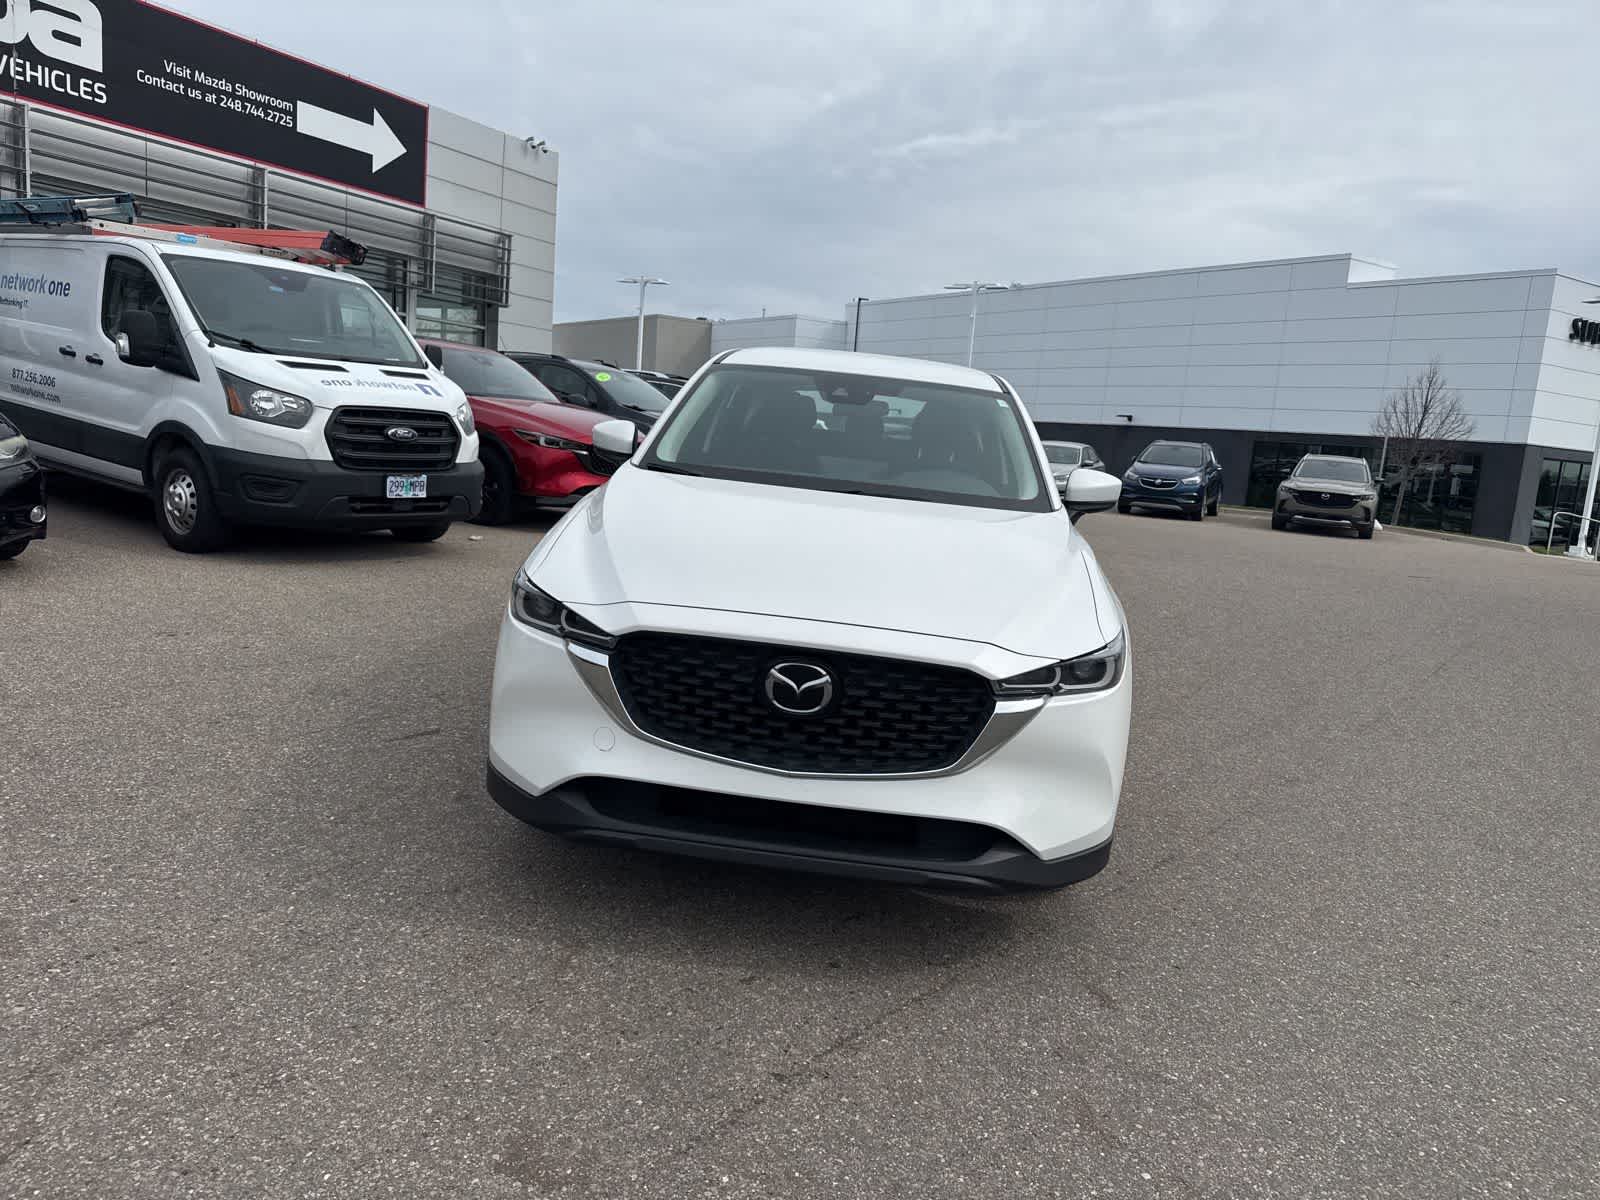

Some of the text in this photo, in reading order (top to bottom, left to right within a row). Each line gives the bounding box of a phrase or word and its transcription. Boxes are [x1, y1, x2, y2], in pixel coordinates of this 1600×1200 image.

[136, 69, 293, 128] Contact us at 248.744.2725
[164, 59, 293, 112] Visit Mazda Showroom
[0, 272, 71, 297] network one
[11, 367, 56, 388] 877.256.2006
